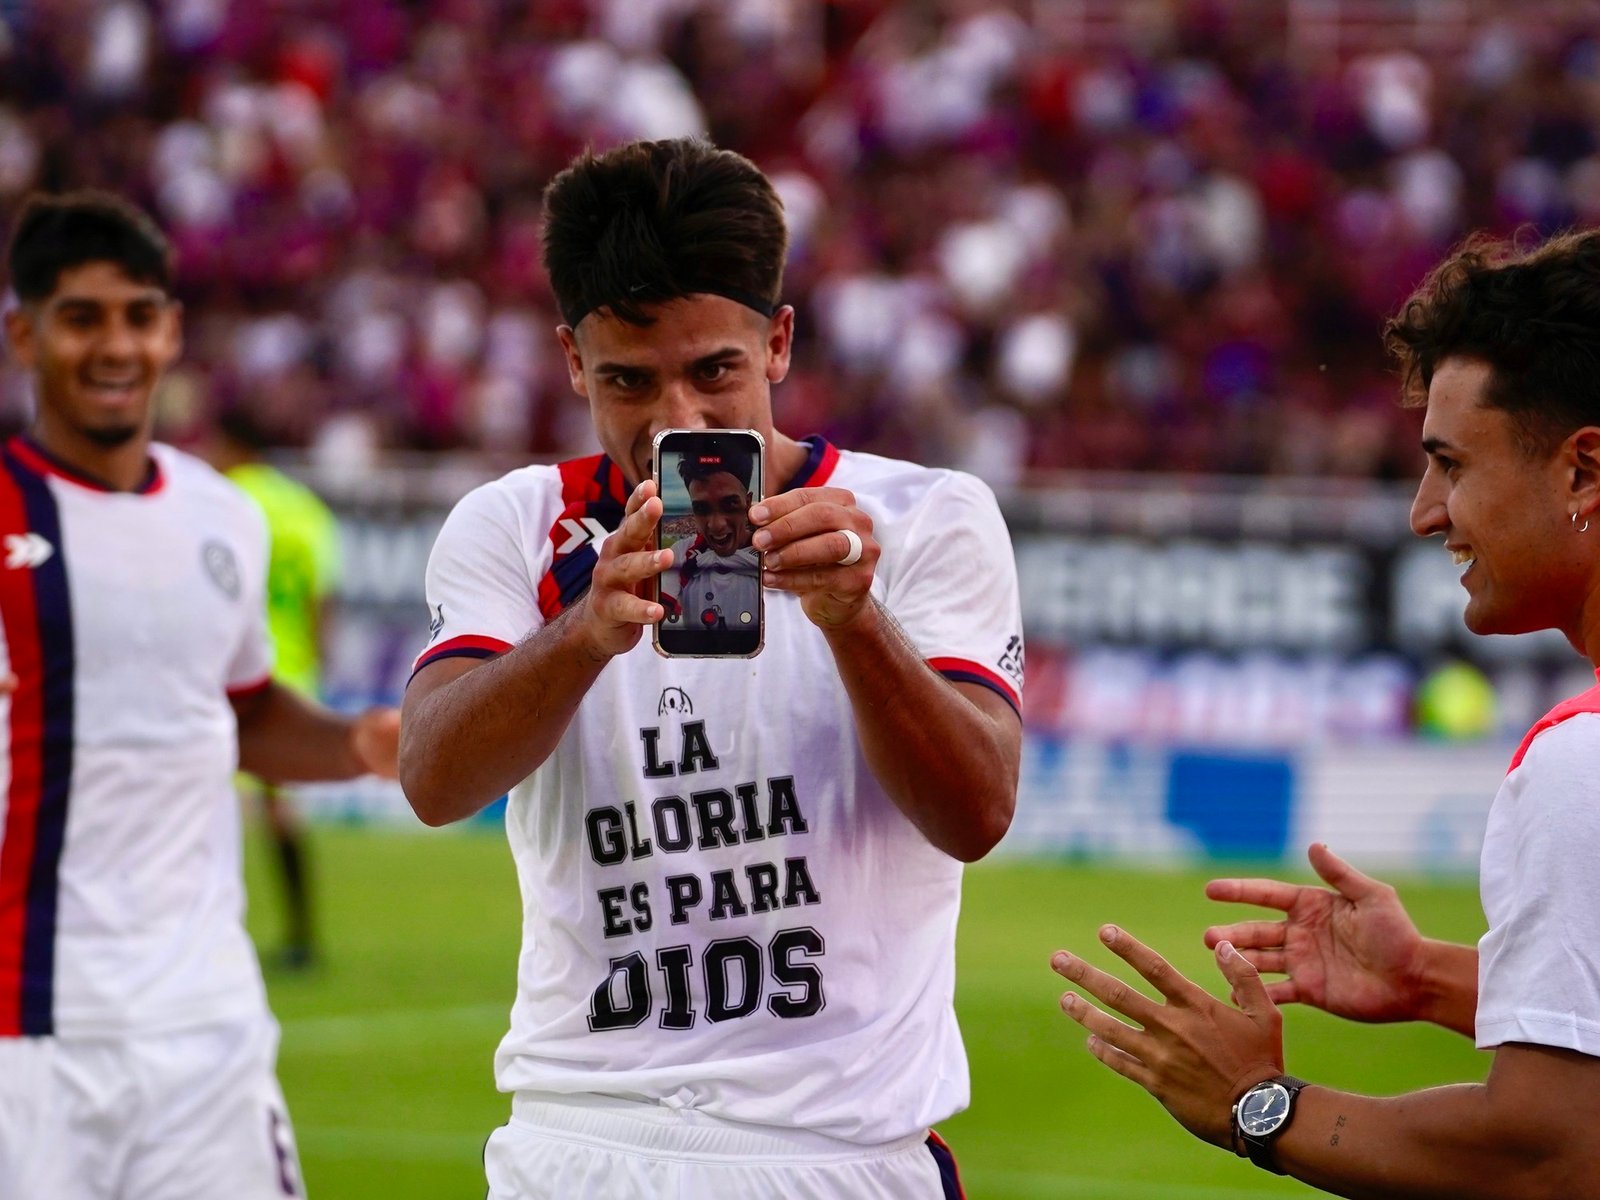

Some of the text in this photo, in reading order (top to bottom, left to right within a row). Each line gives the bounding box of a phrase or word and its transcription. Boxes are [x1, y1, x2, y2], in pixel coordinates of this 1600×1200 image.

[639, 718, 720, 780] LA
[584, 775, 809, 867] GLORIA
[597, 856, 822, 939] ES PARA
[586, 926, 827, 1033] DIOS
